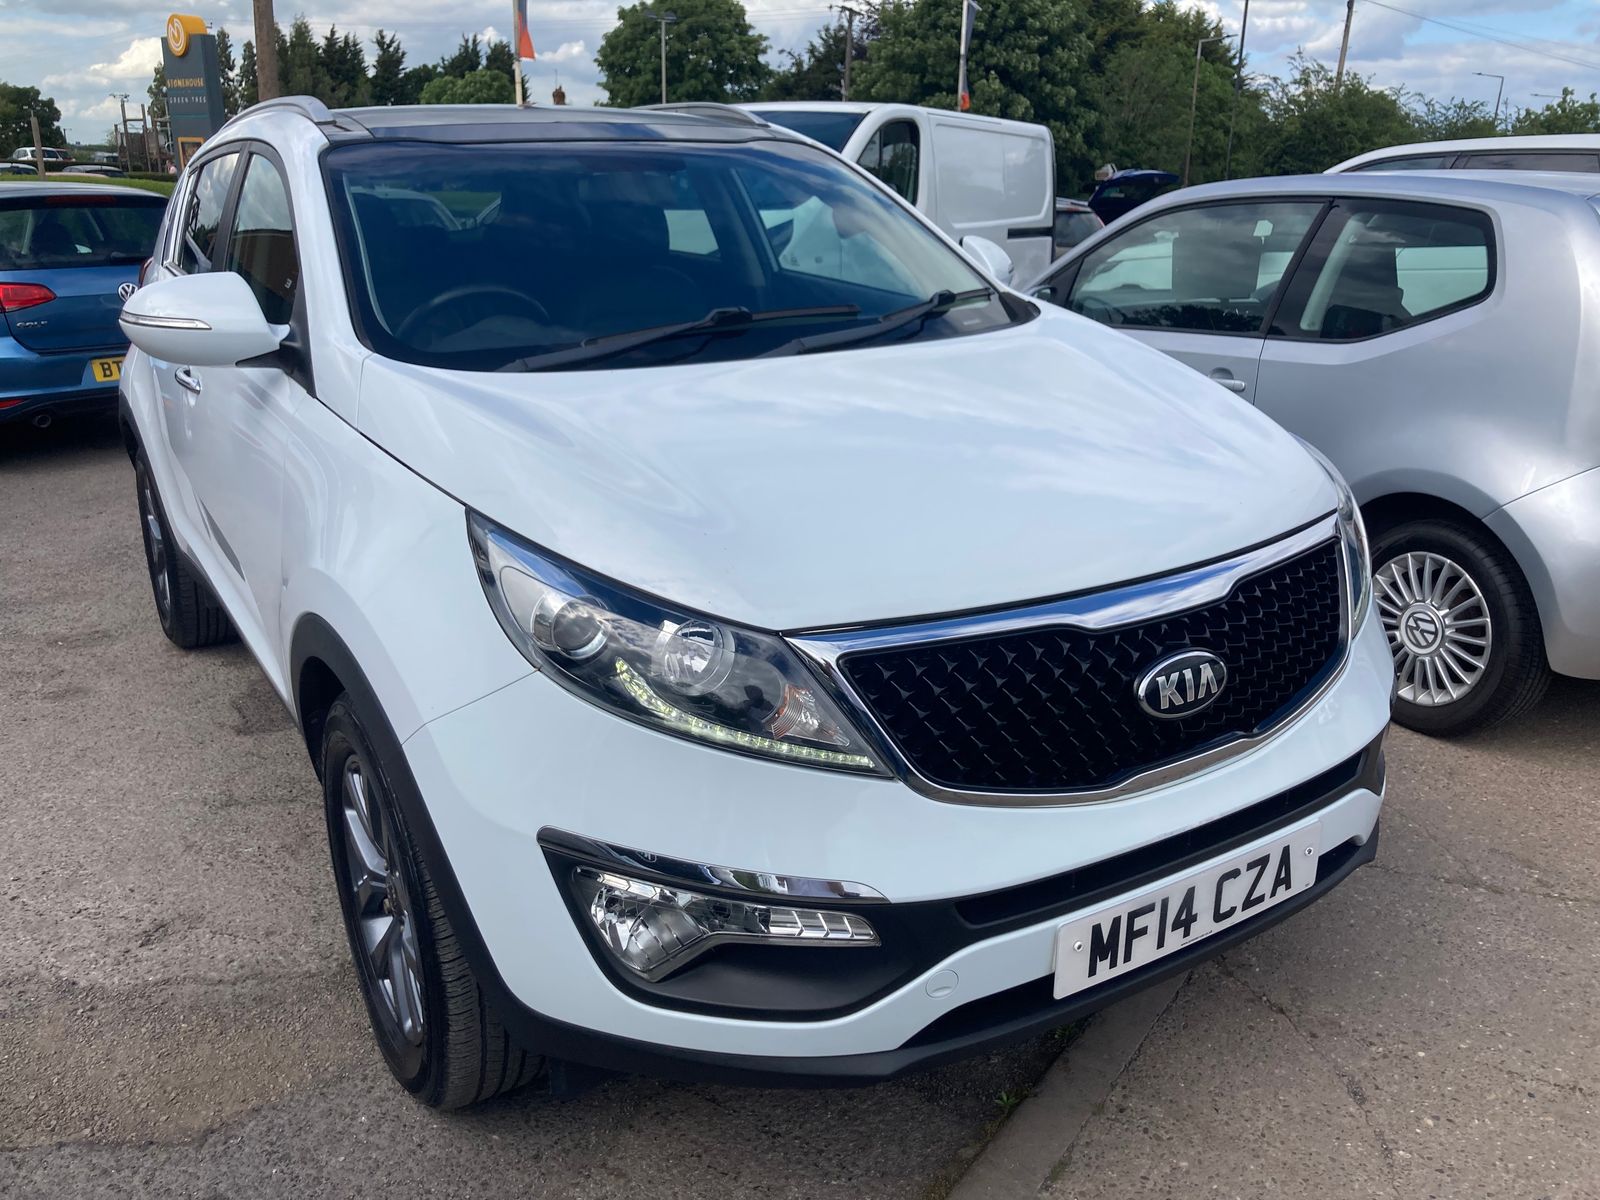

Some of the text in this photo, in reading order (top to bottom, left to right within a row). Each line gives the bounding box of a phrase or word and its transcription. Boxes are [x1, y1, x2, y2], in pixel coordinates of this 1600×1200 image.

[167, 77, 204, 88] STONEHOUSE
[1156, 662, 1218, 710] KIA
[1087, 844, 1293, 979] MF14 CZA
